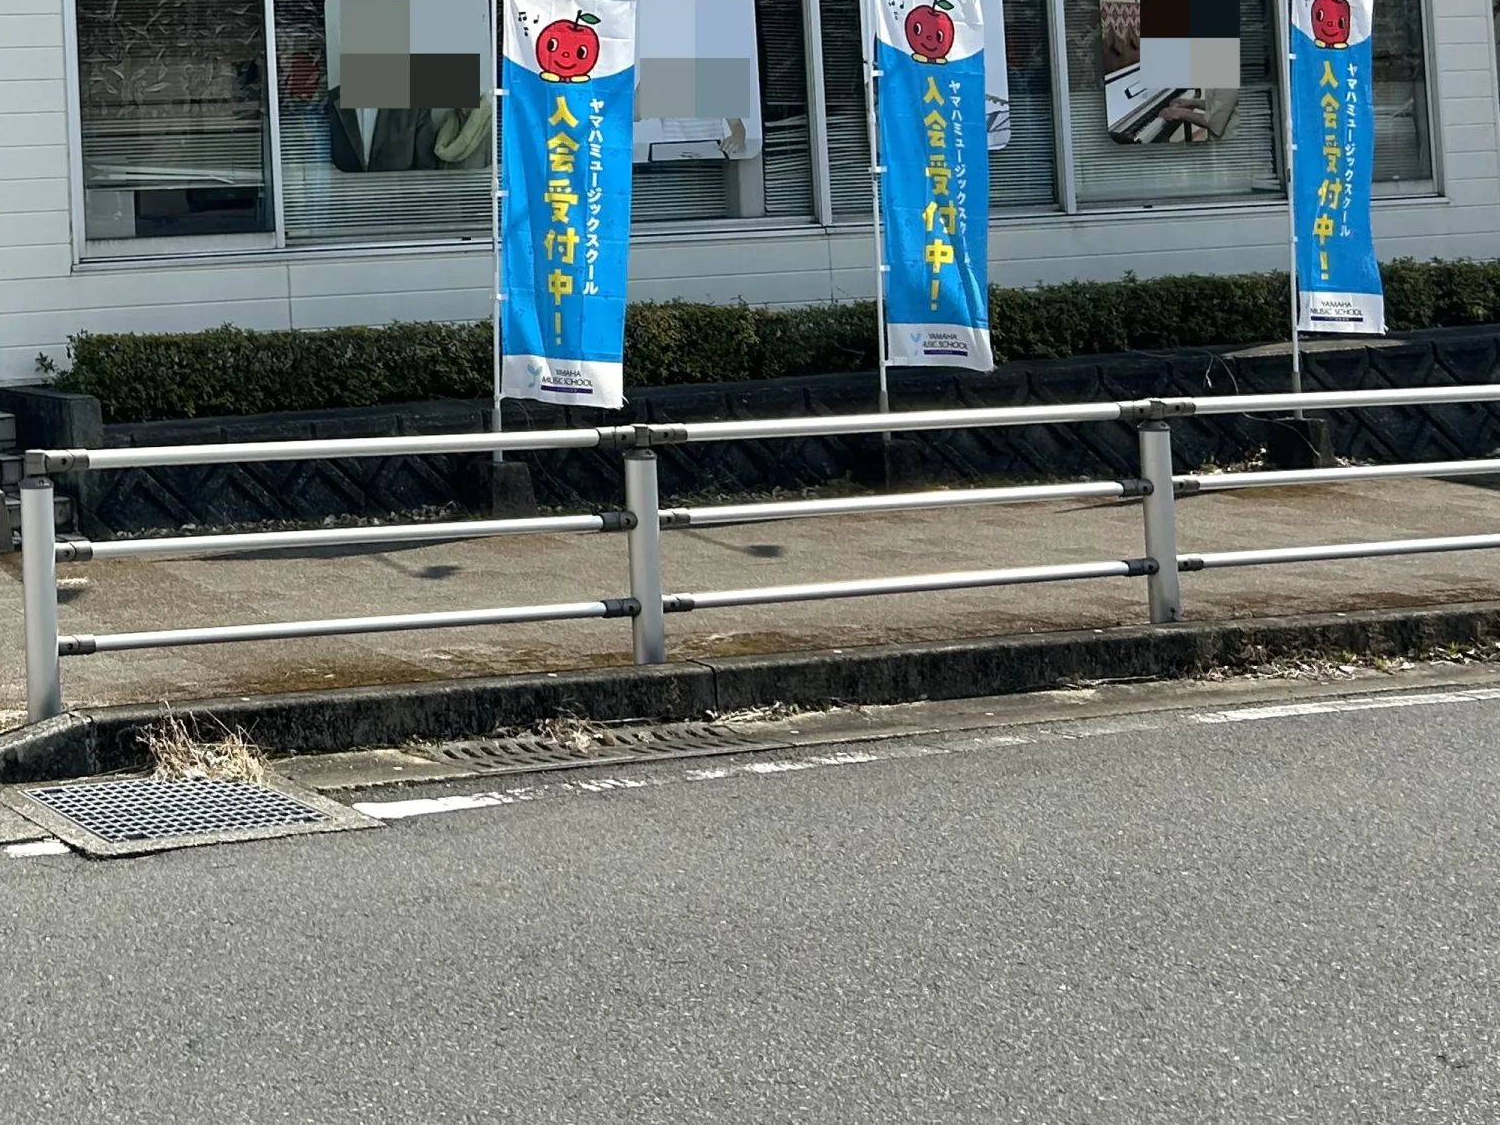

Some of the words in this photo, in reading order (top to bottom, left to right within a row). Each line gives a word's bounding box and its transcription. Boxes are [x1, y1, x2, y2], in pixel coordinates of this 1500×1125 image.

[583, 97, 605, 296] ヤマハミュージックスクール
[1339, 63, 1358, 237] ヤマハミュージックスクール
